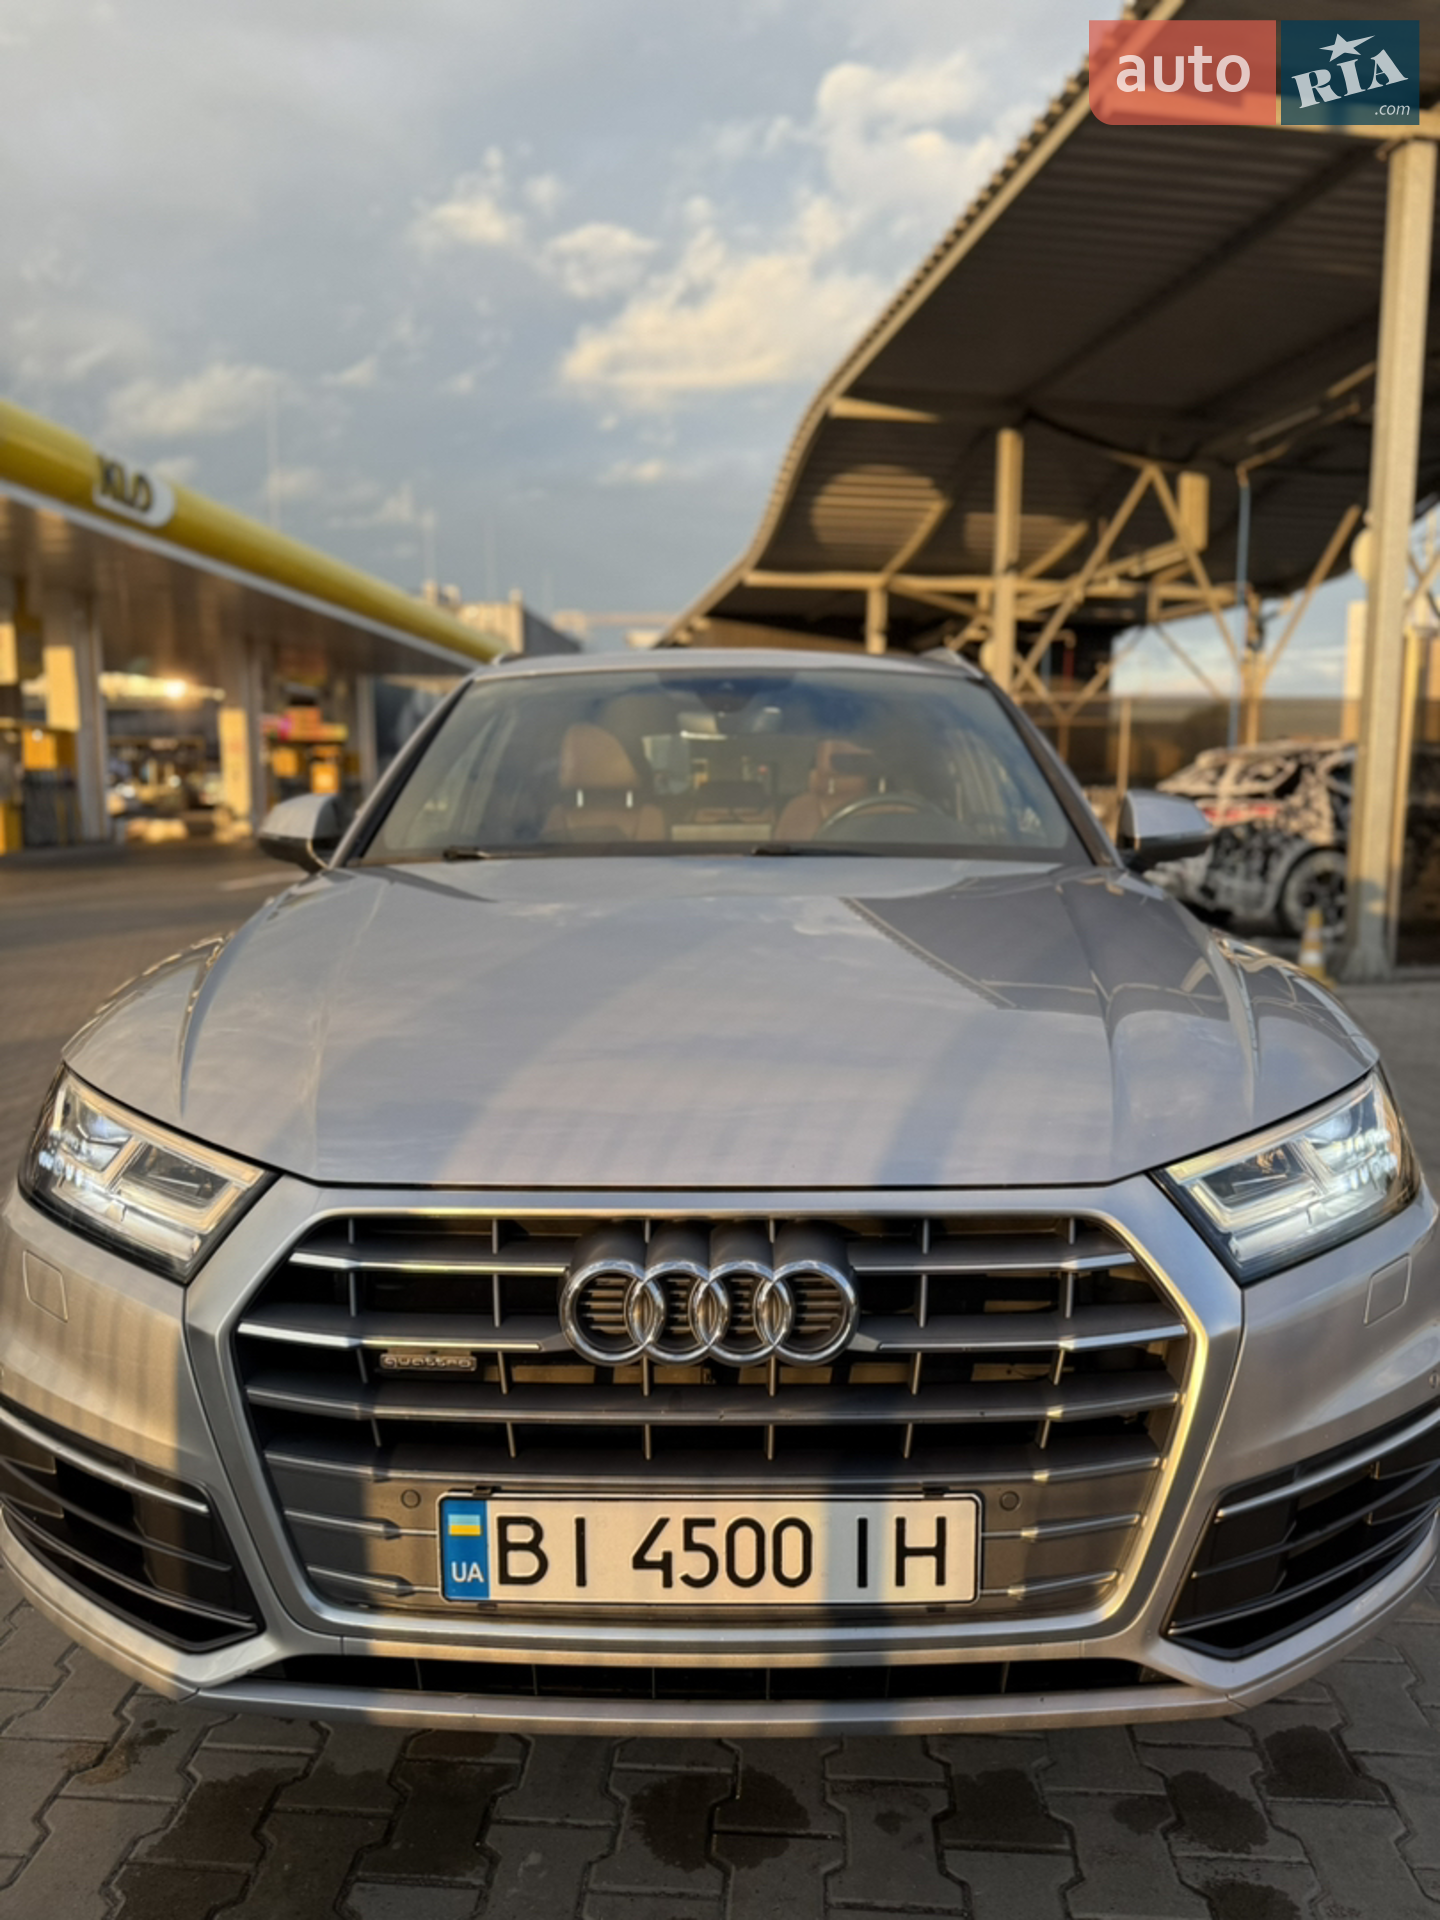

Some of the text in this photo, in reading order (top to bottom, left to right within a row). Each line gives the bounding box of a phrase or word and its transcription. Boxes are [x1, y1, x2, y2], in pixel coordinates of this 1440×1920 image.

[383, 1356, 472, 1368] quattro
[496, 1515, 947, 1588] BI 4500 IH
[451, 1561, 484, 1583] UA
